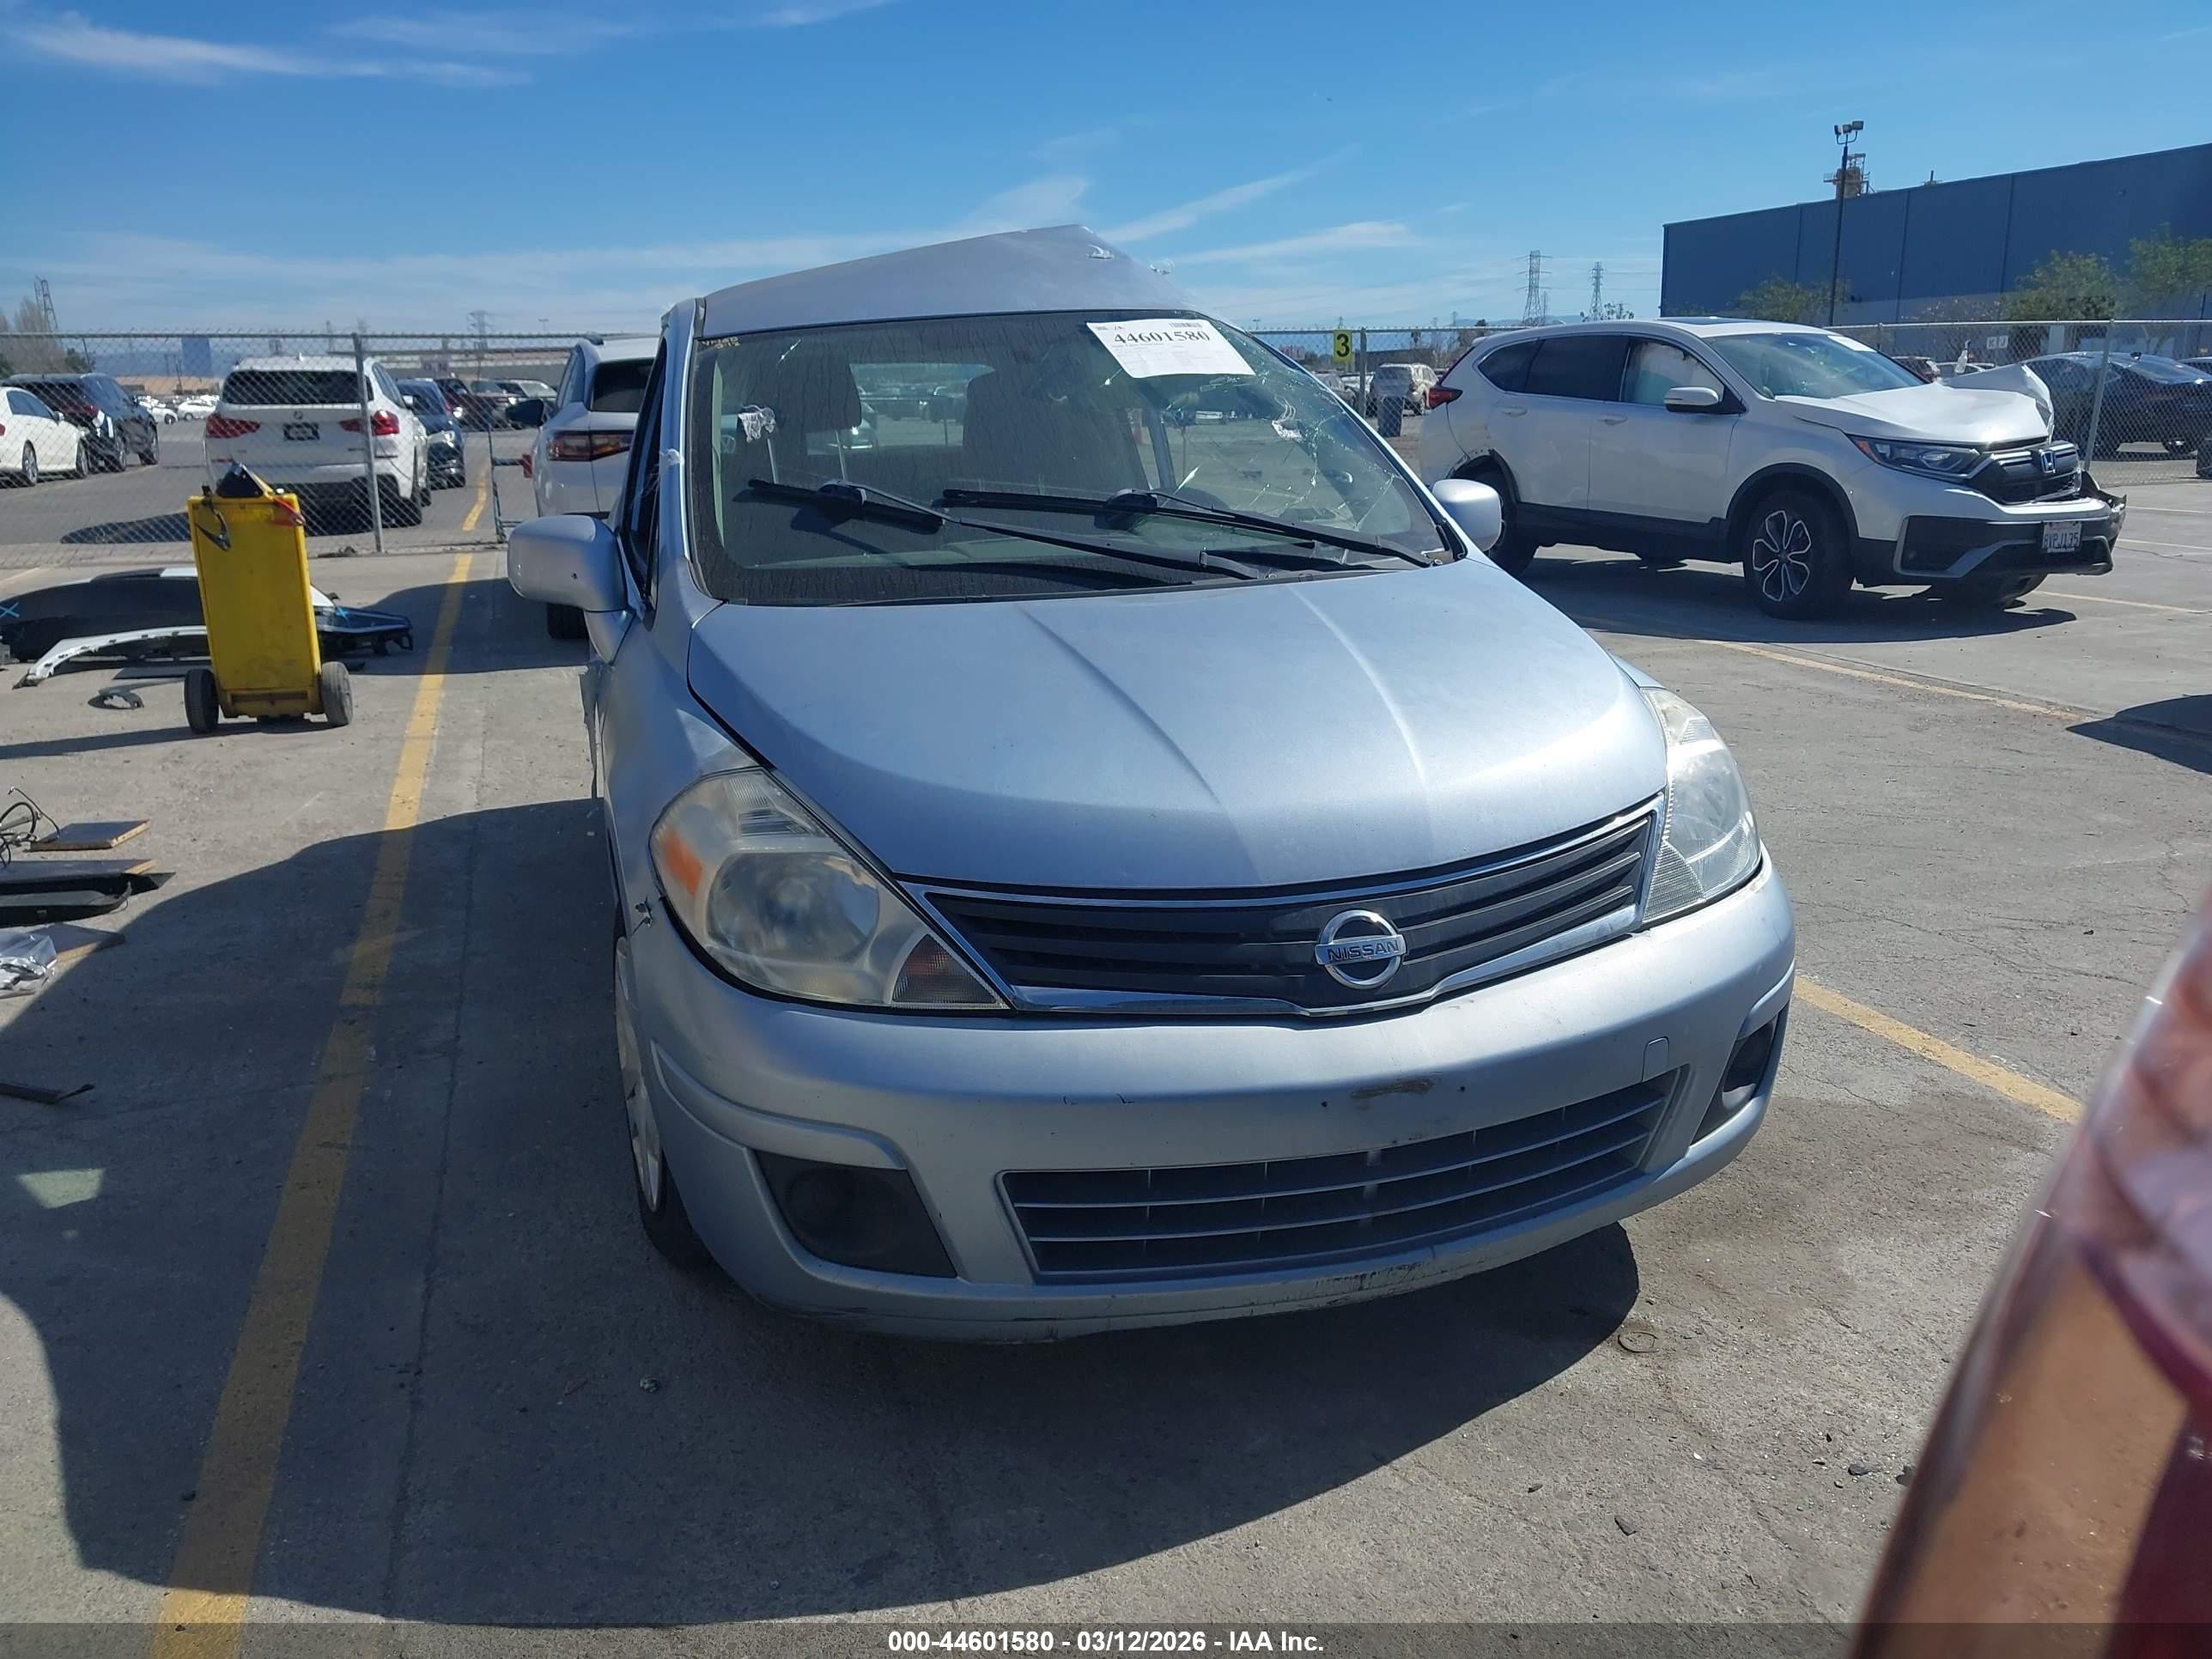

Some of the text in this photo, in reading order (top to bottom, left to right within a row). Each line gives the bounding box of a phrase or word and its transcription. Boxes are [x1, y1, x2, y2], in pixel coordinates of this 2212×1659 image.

[1114, 331, 1210, 343] 44601580
[1336, 333, 1350, 357] 3
[1328, 940, 1399, 961] NISSAN
